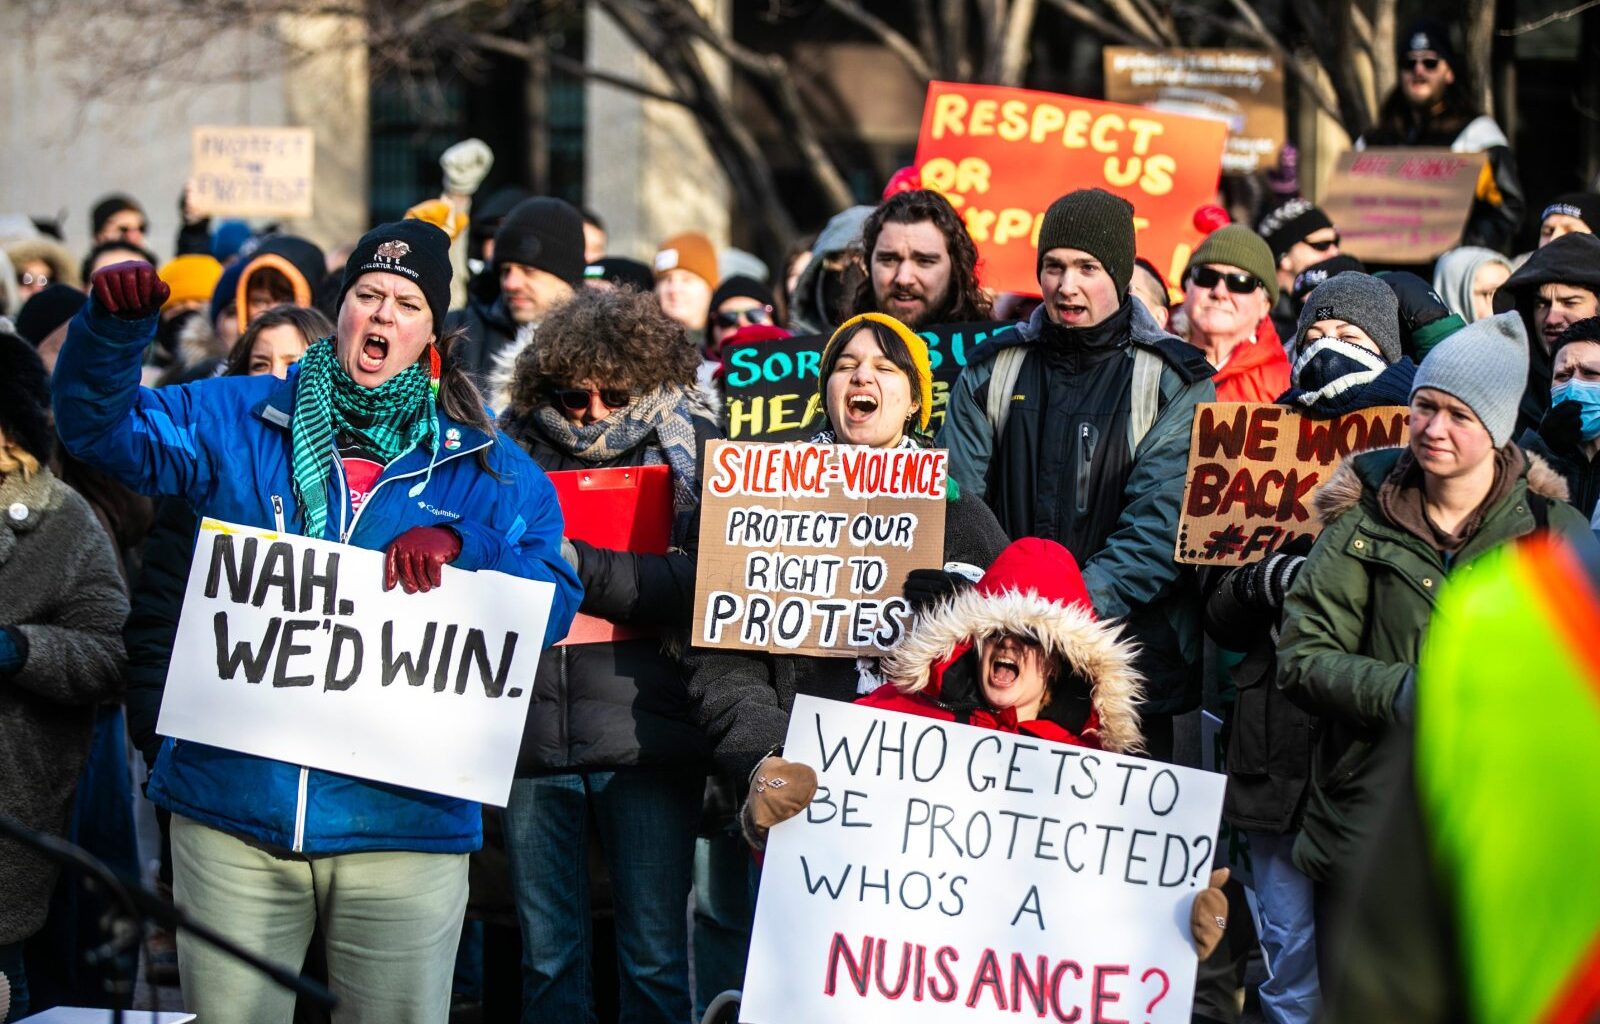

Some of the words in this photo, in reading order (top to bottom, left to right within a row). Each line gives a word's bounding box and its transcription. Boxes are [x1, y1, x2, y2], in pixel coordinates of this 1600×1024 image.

[931, 94, 1164, 155] RESPECT
[920, 157, 992, 194] OR
[1104, 154, 1176, 195] US
[1199, 405, 1282, 462] WE
[427, 504, 460, 519] Columbia
[1187, 463, 1319, 522] BACK
[729, 511, 846, 543] PROTECT
[852, 515, 912, 543] OUR
[204, 534, 354, 616] NAH.
[748, 556, 841, 593] RIGHT
[851, 559, 883, 591] TO
[709, 595, 906, 647] PROTES
[214, 611, 364, 693] WE'D
[382, 620, 523, 698] WIN.
[815, 713, 947, 783] WHO
[967, 735, 1101, 799] GETS
[1115, 762, 1179, 816] TO
[807, 786, 872, 828] BE
[902, 798, 1212, 887] PROTECTED?
[800, 856, 967, 916] WHO'S
[1011, 884, 1045, 930] A
[824, 932, 1171, 1024] NUISANCE?
